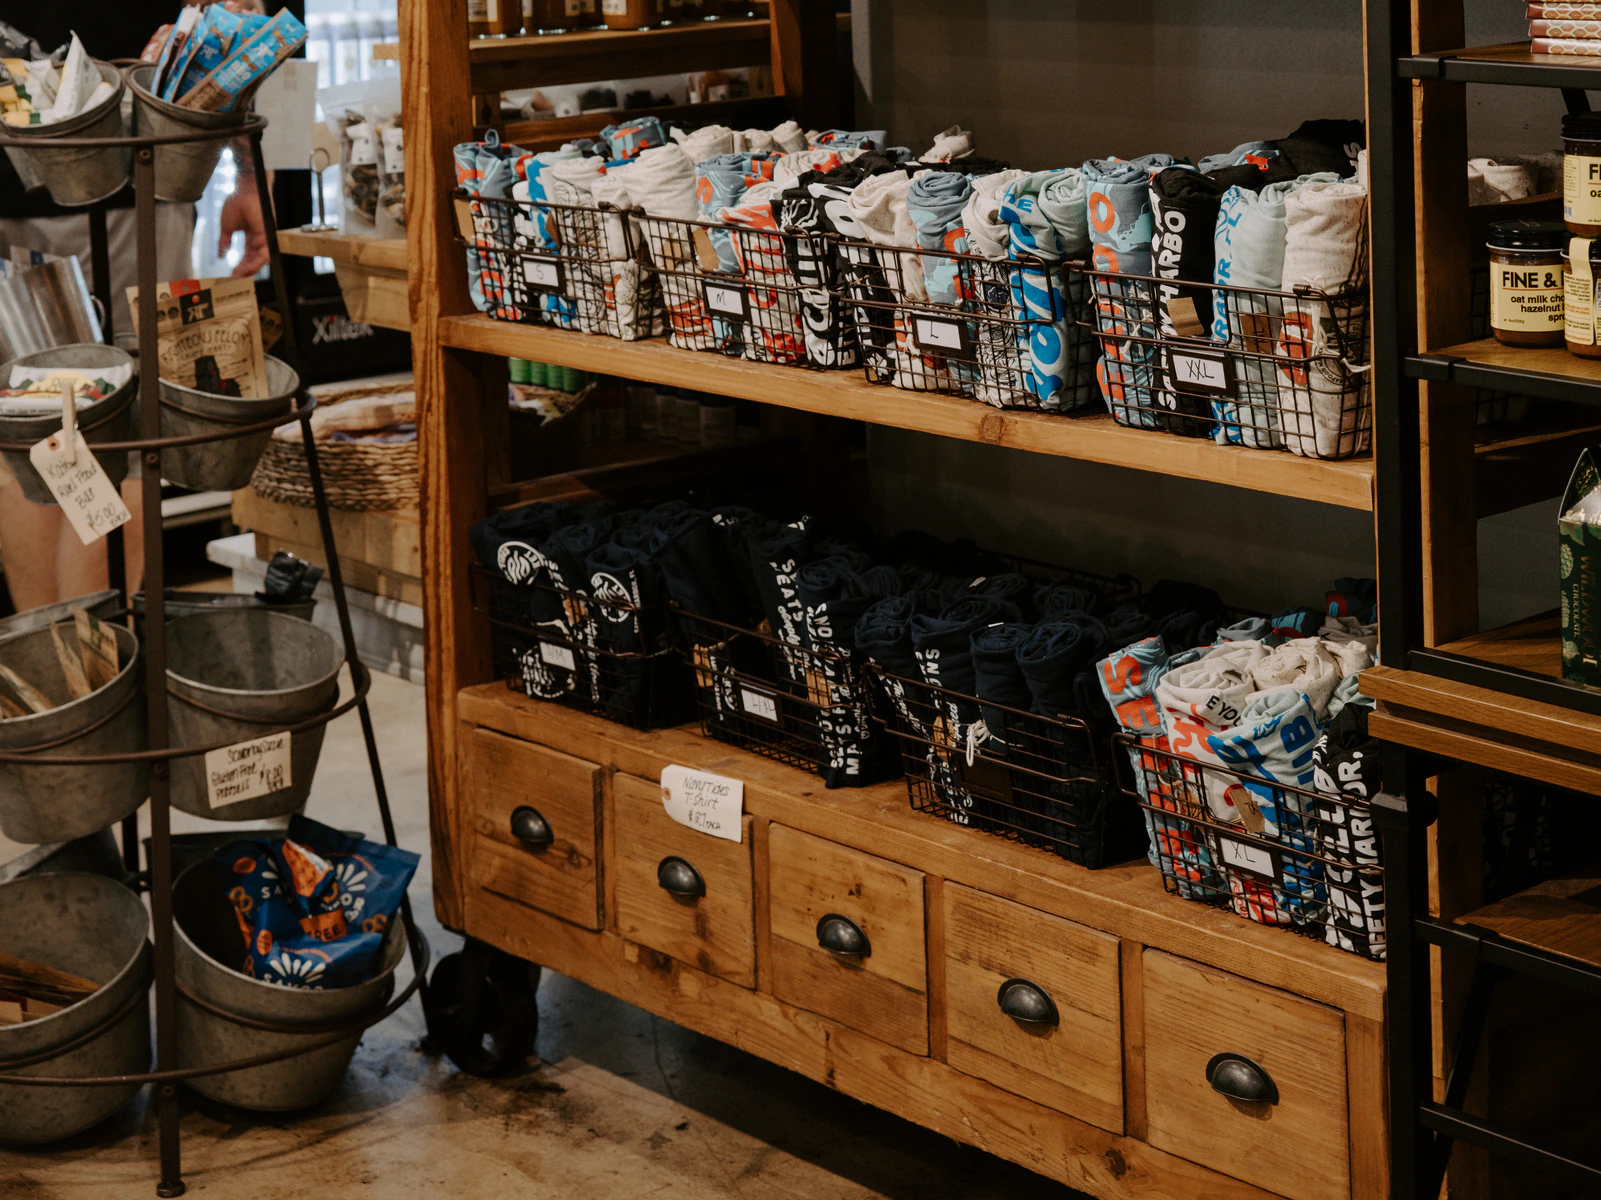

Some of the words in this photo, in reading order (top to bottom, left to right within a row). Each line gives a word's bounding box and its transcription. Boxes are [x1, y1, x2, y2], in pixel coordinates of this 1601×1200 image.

[1157, 209, 1187, 304] HARBO
[535, 264, 544, 280] S
[1502, 270, 1539, 288] FINE
[1543, 272, 1558, 288] &
[715, 289, 728, 307] M
[1510, 295, 1525, 303] oat
[1528, 294, 1548, 303] milk
[1550, 294, 1565, 303] cho
[1520, 304, 1561, 313] hazelnut
[930, 320, 939, 339] L
[1186, 359, 1215, 379] XXL
[1572, 582, 1581, 638] CHOCOLATE
[704, 780, 731, 797] Tides
[684, 791, 720, 809] T-Shirt
[1230, 840, 1257, 863] XL
